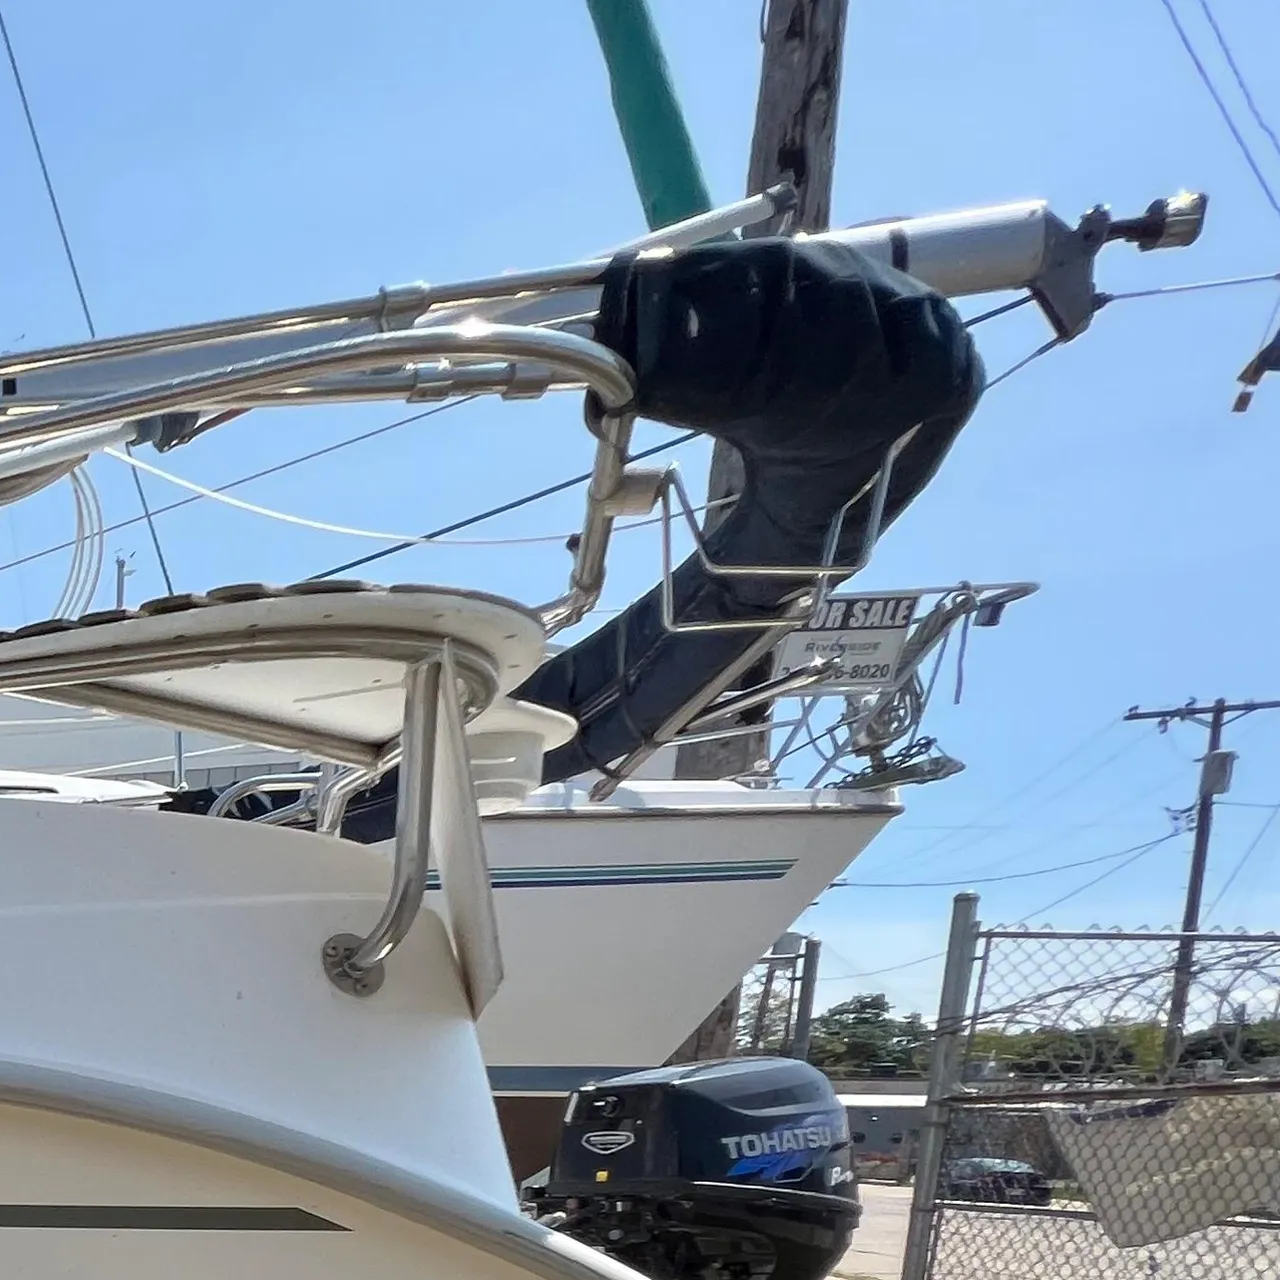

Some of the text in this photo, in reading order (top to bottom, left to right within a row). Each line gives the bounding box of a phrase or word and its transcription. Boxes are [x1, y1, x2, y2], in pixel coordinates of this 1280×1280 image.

[807, 598, 914, 629] OR SALE
[720, 1126, 832, 1159] TOHATSU
